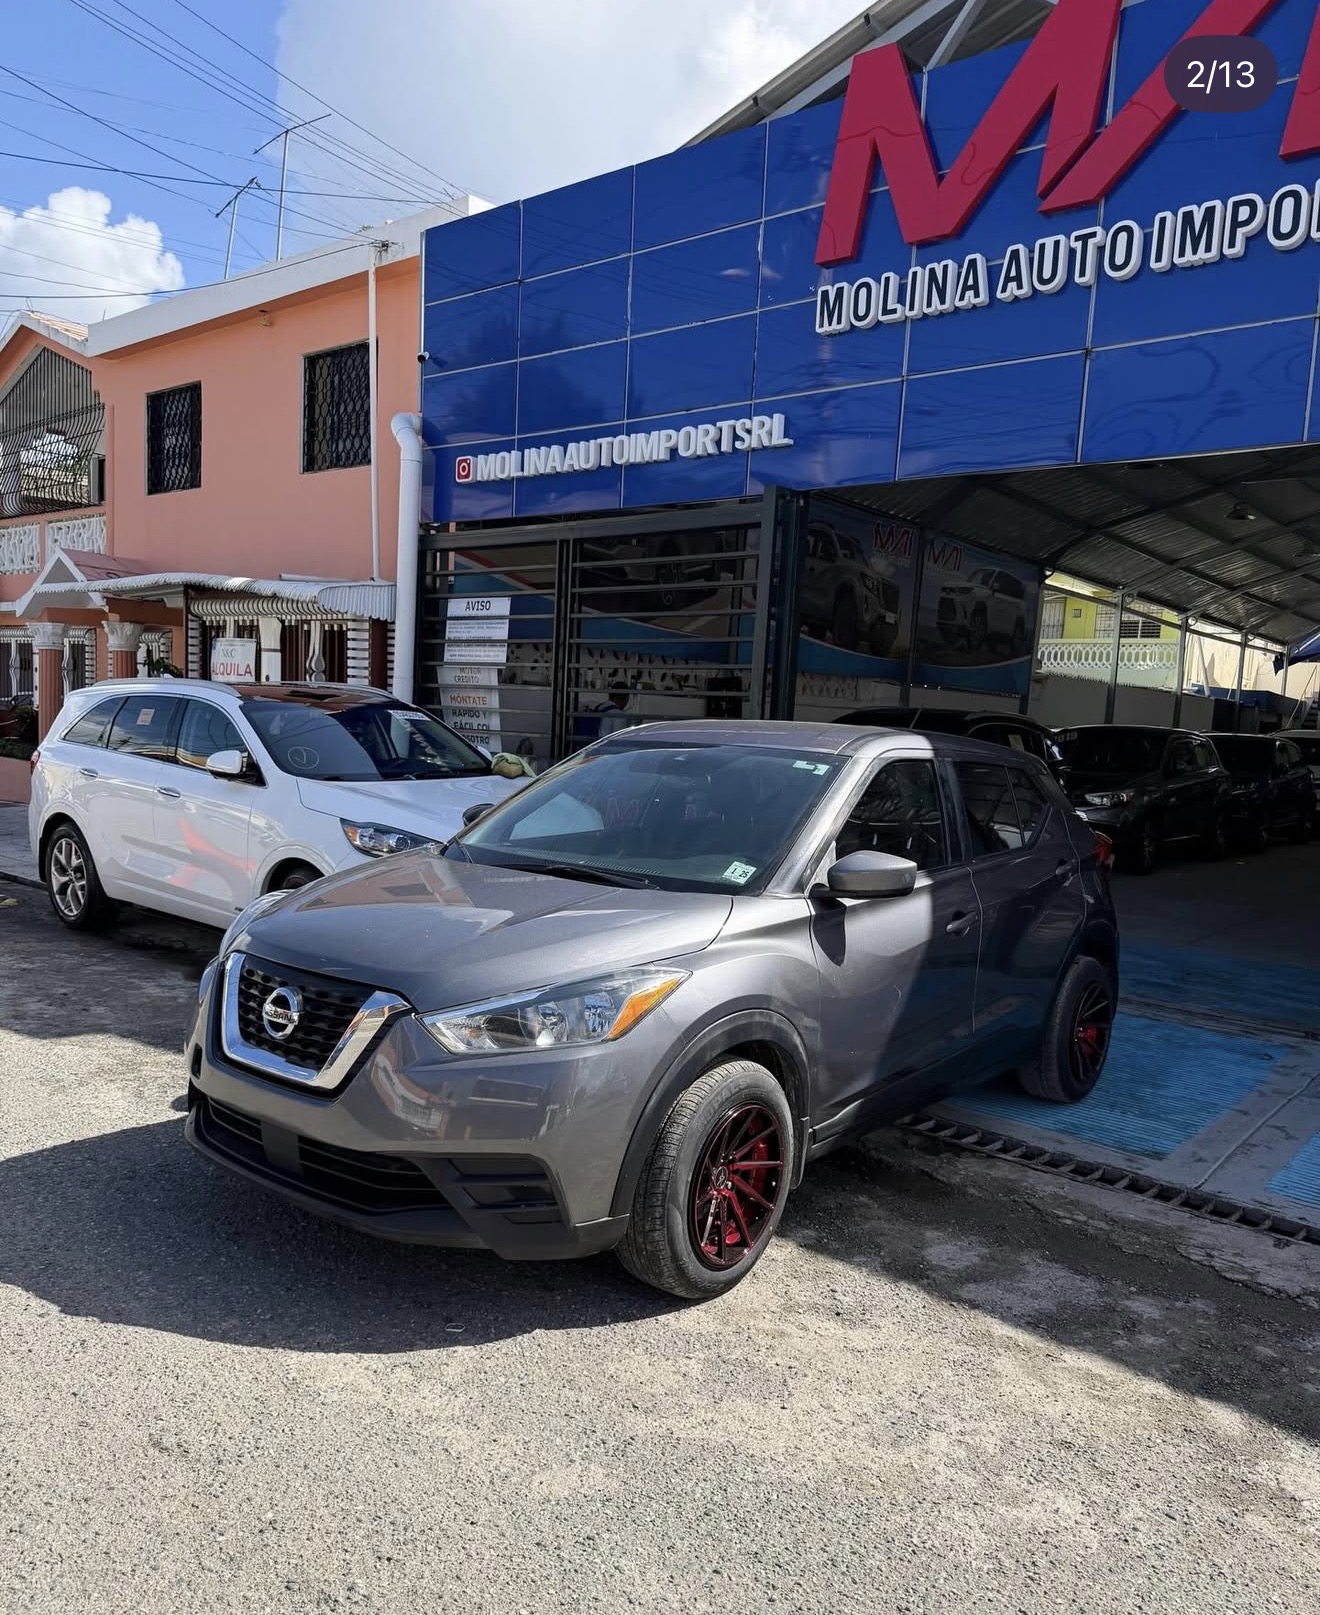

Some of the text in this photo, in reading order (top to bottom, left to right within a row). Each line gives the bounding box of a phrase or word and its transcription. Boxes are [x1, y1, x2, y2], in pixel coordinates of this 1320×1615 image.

[815, 177, 1320, 335] MOLINA AUTO IMPO
[476, 413, 794, 482] MOLINAAUTOIMPORTSRL
[465, 600, 492, 612] AVISO
[459, 667, 482, 675] MOTOR
